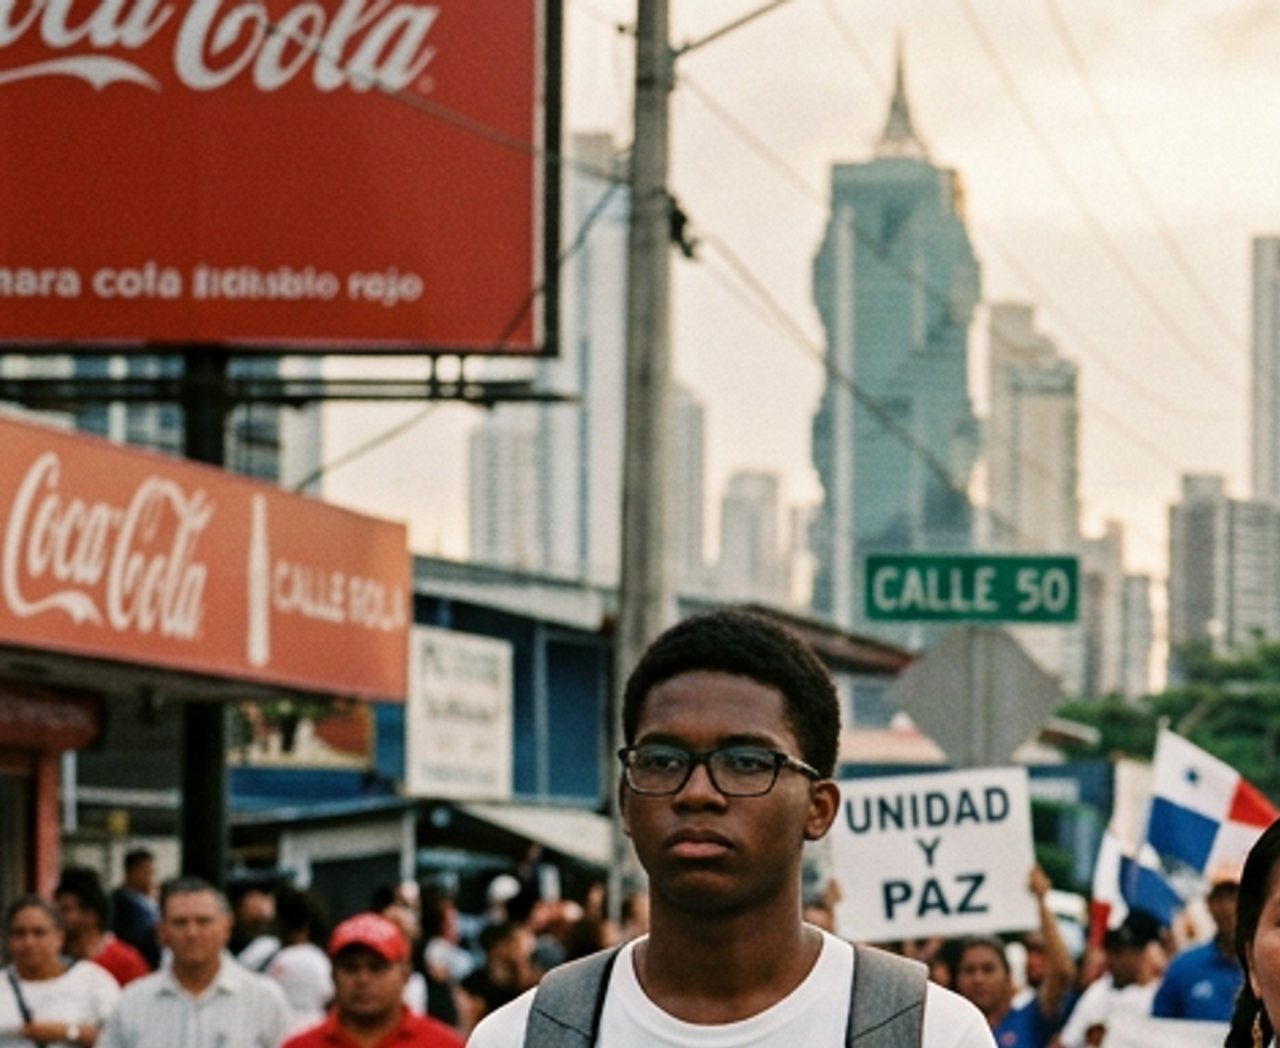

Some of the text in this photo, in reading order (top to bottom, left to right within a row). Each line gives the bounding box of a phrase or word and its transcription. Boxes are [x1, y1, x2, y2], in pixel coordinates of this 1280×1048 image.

[872, 565, 1071, 614] CALLE 50
[846, 786, 1010, 834] UNIDAD
[915, 836, 941, 868] Y
[883, 873, 990, 921] PAZ
